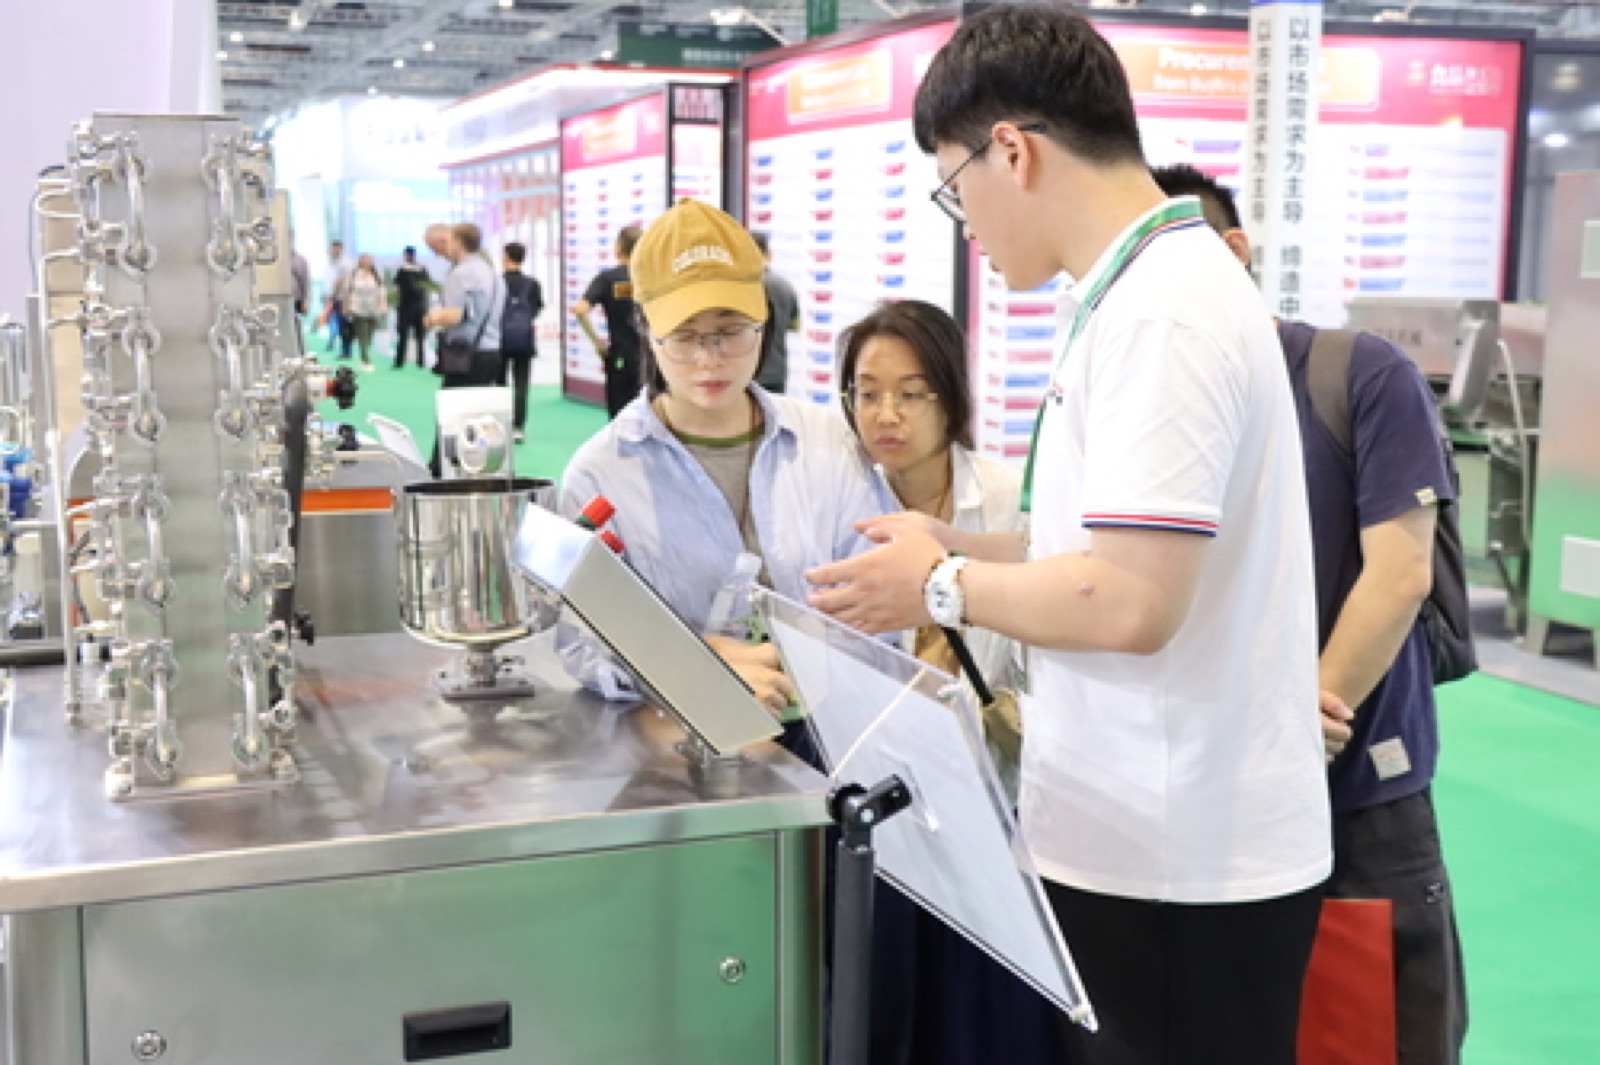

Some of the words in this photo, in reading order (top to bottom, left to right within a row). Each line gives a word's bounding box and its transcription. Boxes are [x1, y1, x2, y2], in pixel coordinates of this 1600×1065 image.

[1284, 17, 1310, 223] 以市场需求为主导
